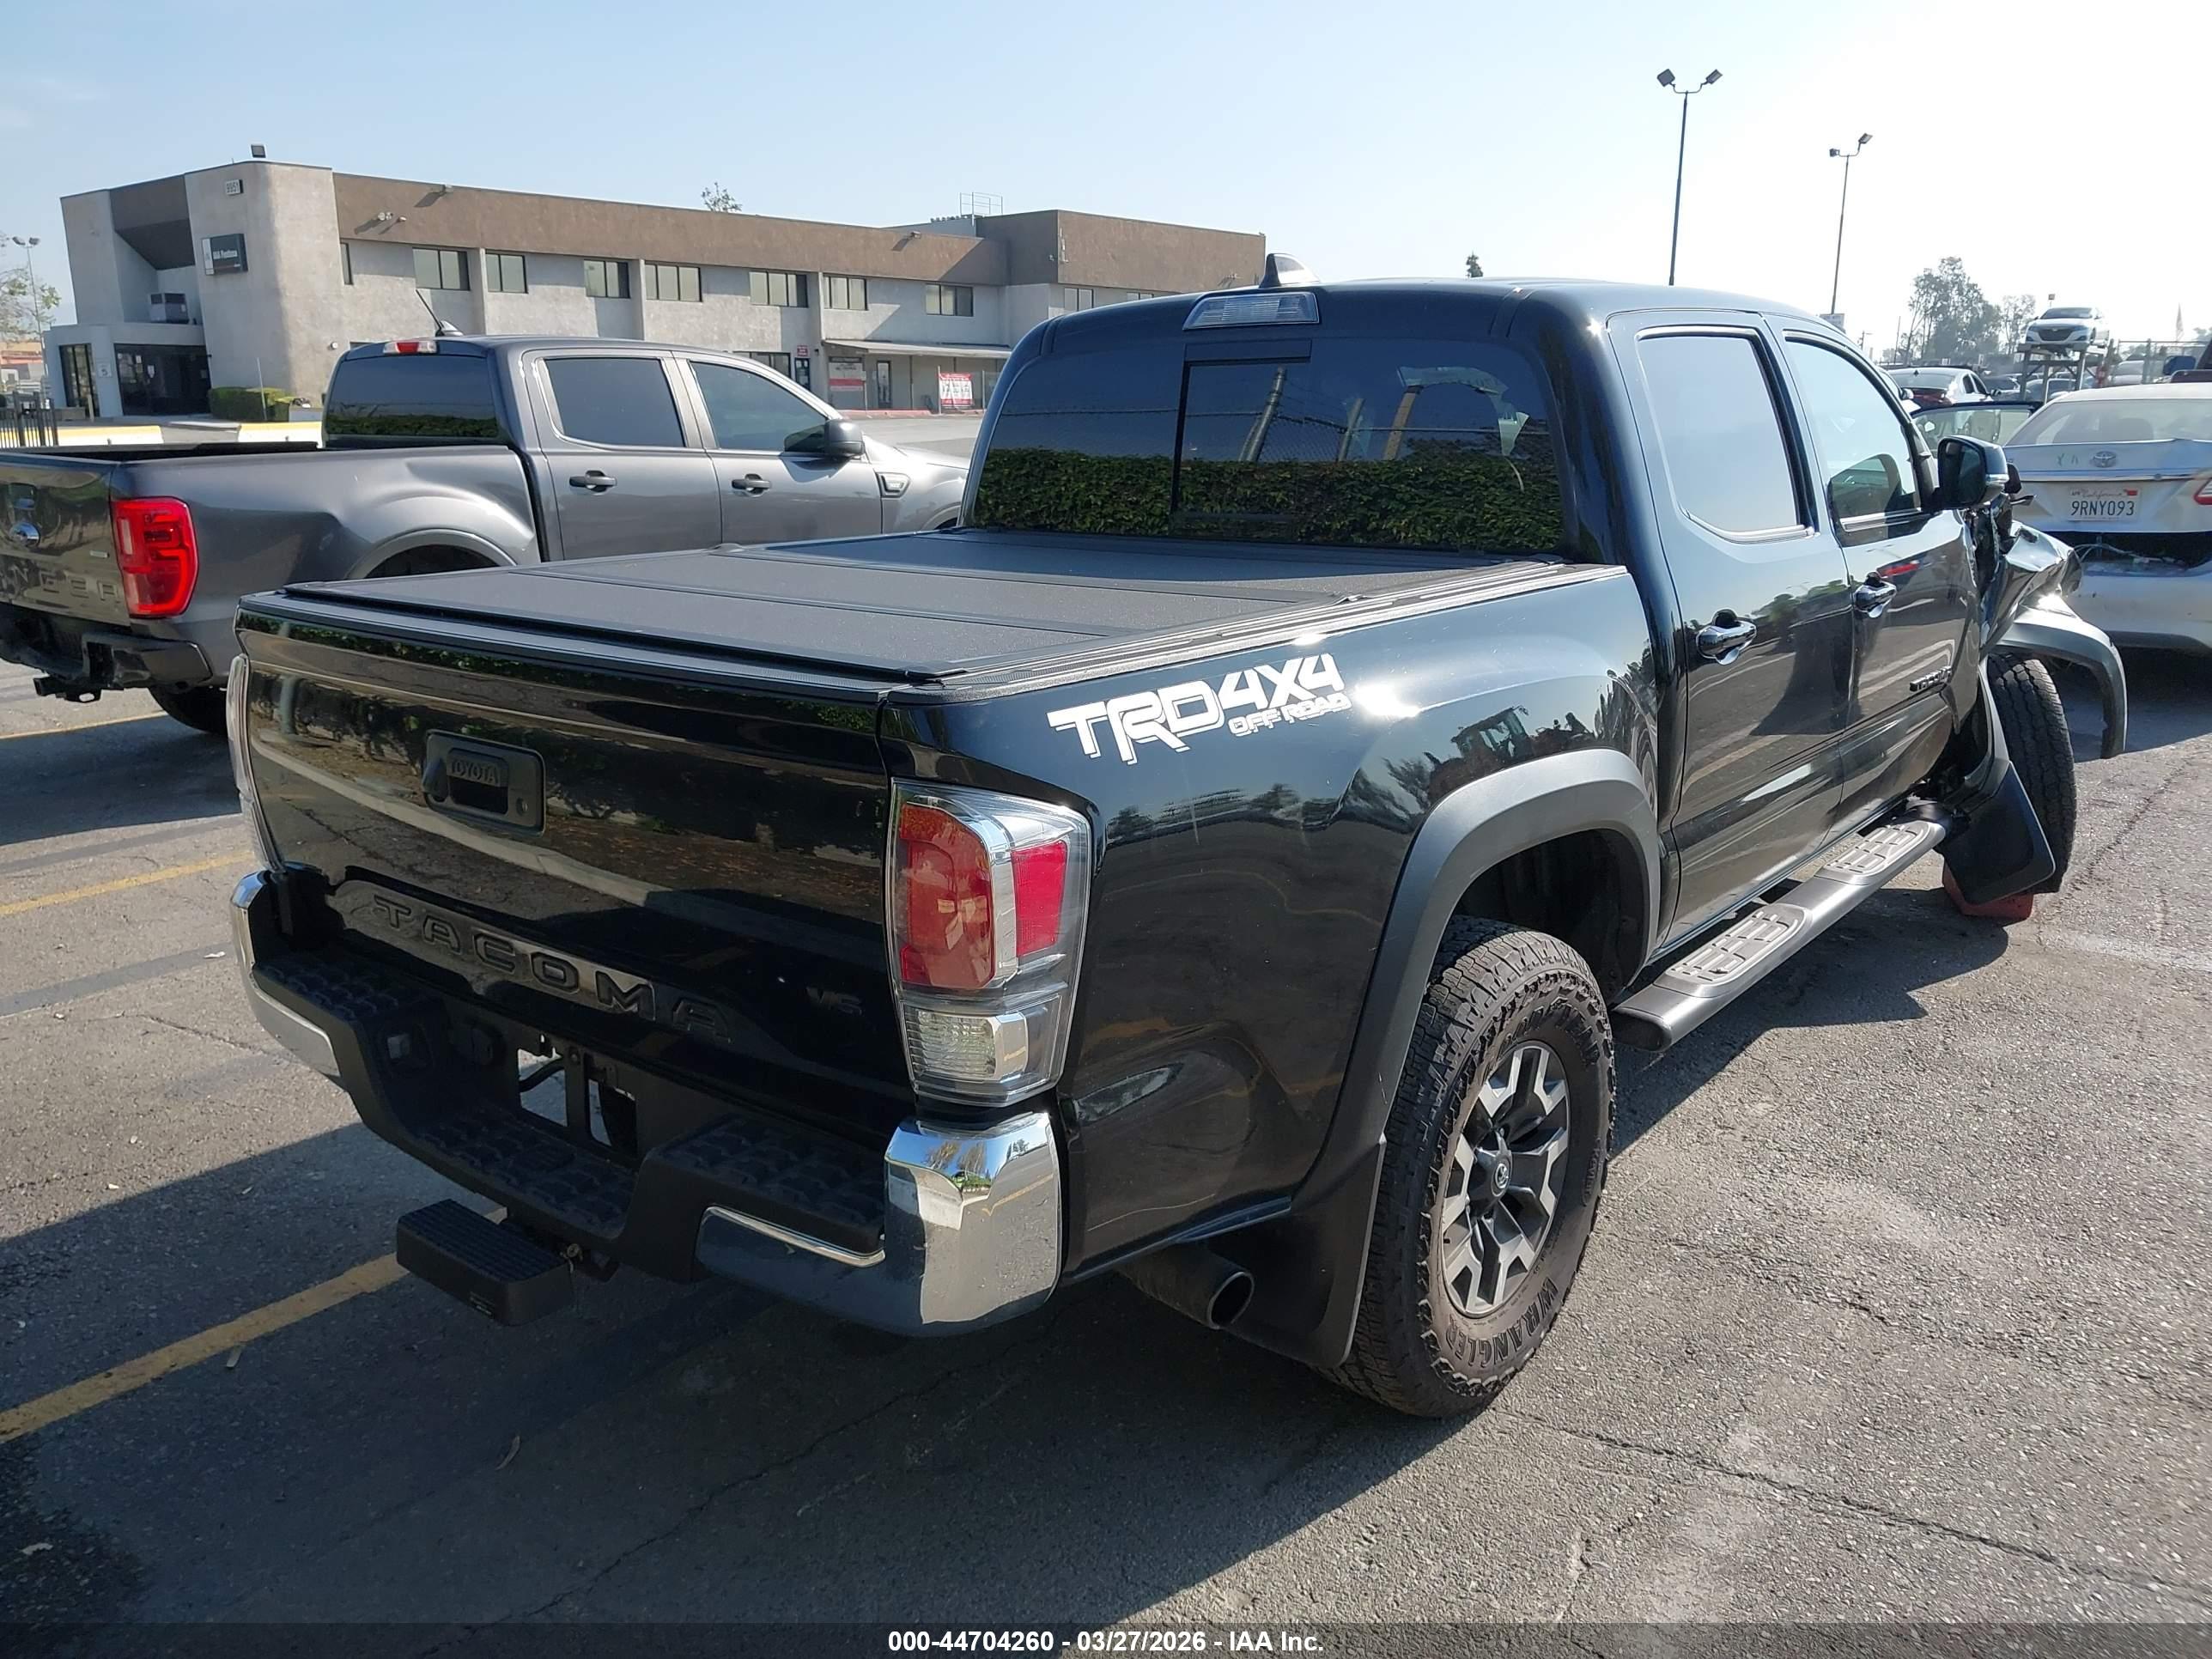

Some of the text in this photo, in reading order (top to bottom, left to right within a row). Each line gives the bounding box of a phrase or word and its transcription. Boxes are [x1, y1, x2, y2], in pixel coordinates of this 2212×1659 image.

[2070, 500, 2136, 516] 9RNY093
[1047, 680, 1224, 765] TRD
[1227, 691, 1352, 738] OFF ROAD
[450, 759, 501, 785] TOYOTA
[373, 894, 730, 1042] TACOMA
[1445, 1278, 1559, 1368] WRANGLER
